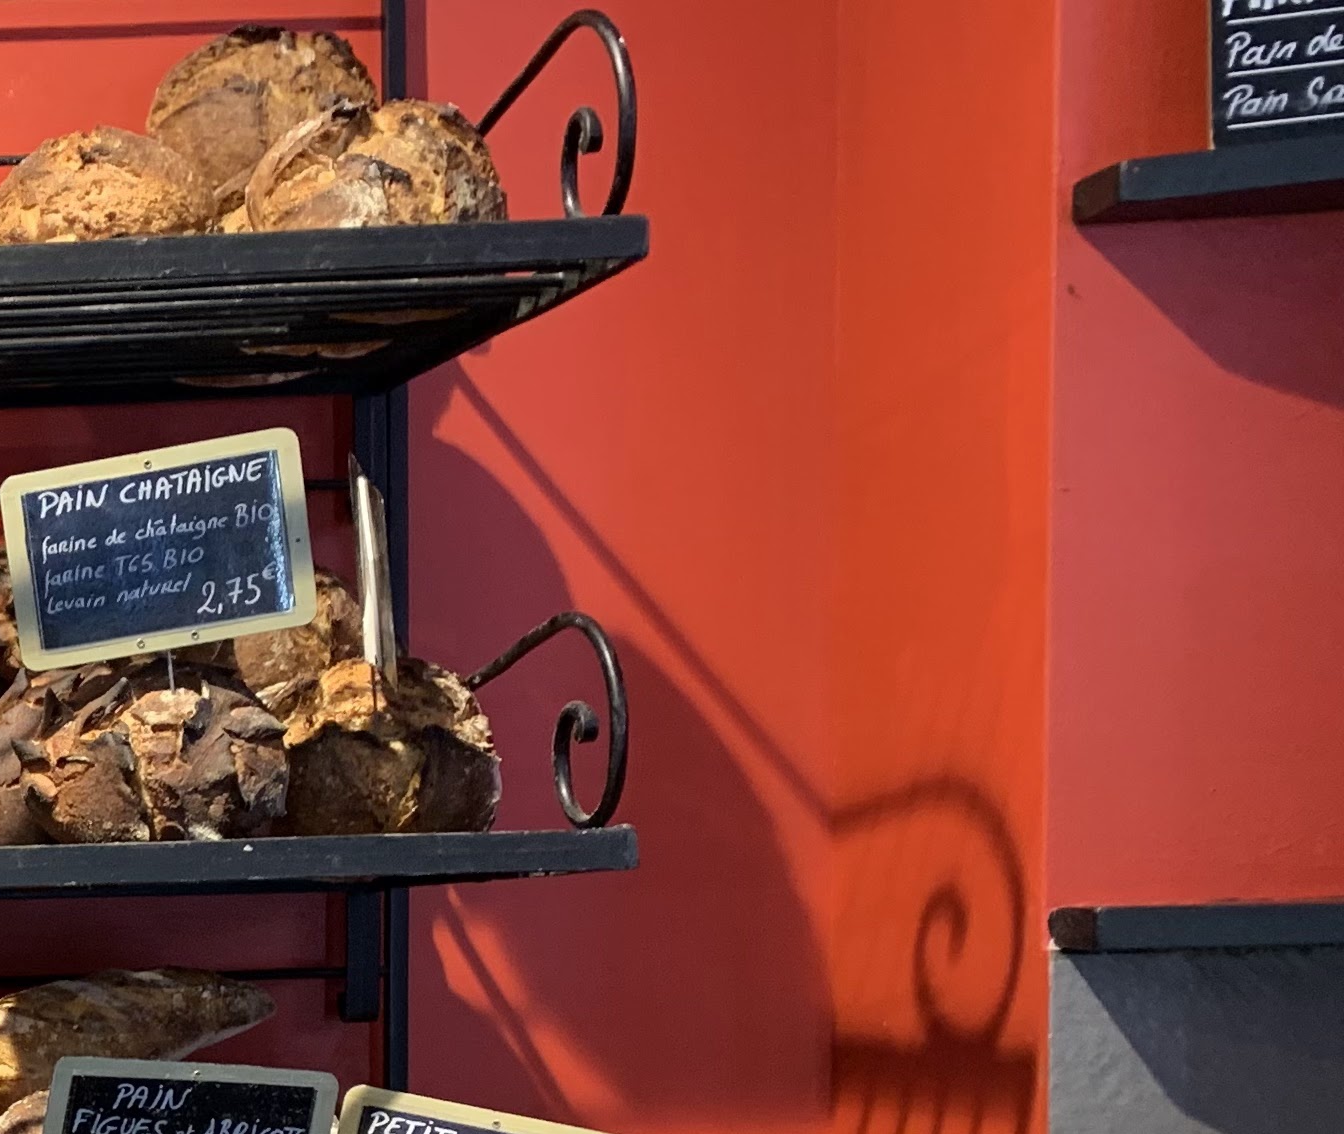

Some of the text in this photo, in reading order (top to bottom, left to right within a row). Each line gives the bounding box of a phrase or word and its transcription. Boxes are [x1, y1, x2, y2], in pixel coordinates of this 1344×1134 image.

[1222, 84, 1289, 120] Pain
[38, 458, 267, 519] PAIN CHATAIGNE
[42, 536, 97, 564] farine
[105, 528, 127, 547] de
[235, 499, 273, 528] BIO
[45, 546, 204, 598] farine T65 BIO
[47, 572, 192, 615] levain naturel
[112, 1083, 193, 1110] PAIN
